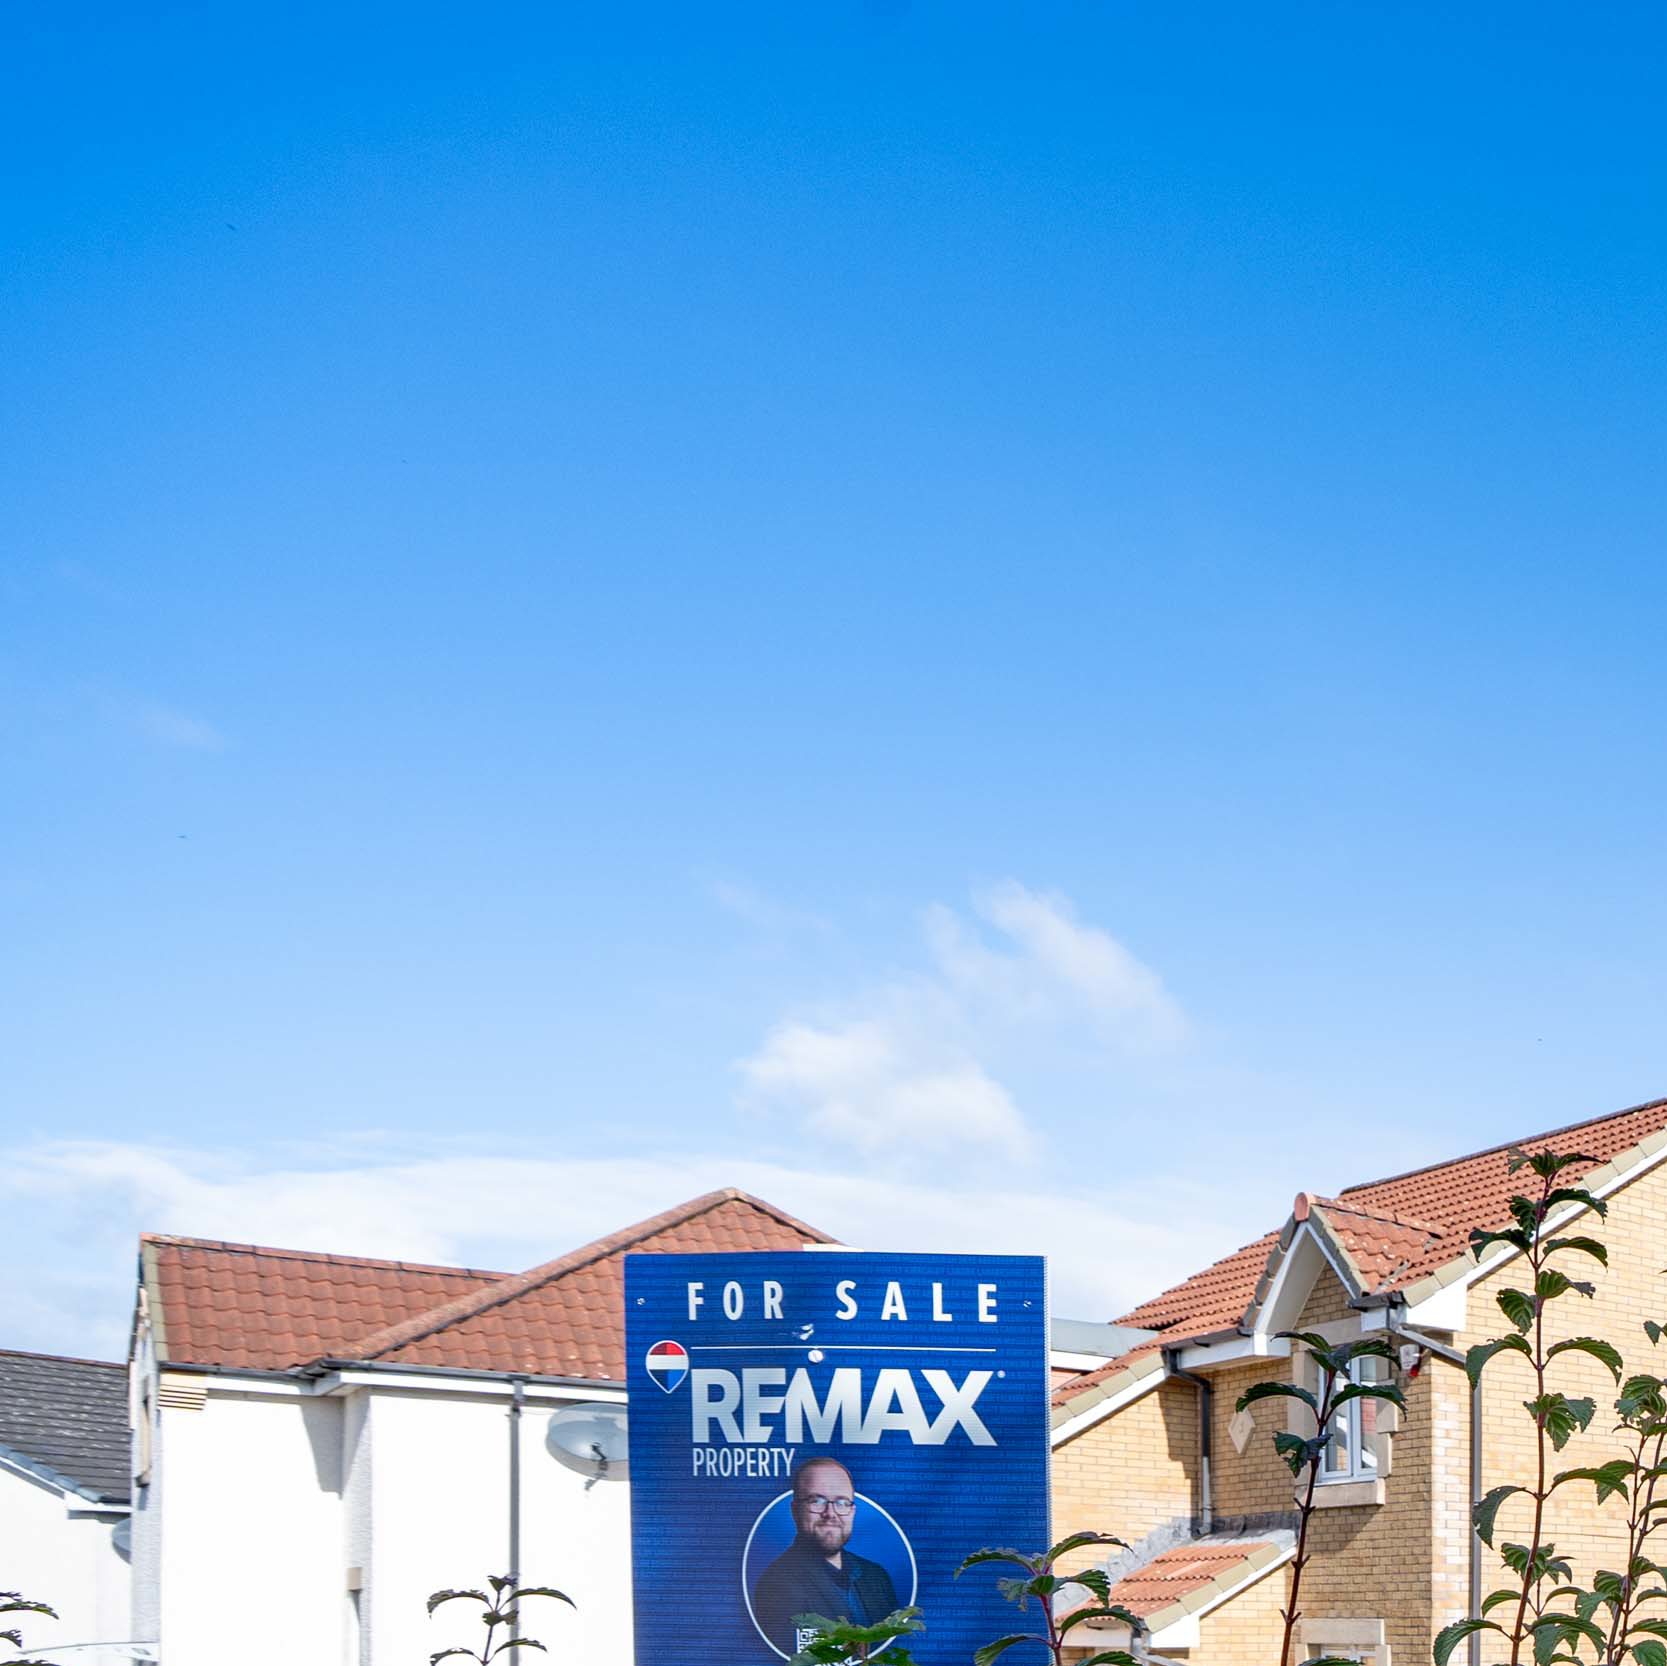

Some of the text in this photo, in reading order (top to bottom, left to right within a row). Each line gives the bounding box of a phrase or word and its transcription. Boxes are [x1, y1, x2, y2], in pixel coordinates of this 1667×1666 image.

[688, 1280, 998, 1323] FOR SALE
[693, 1447, 796, 1478] PROPERTY
